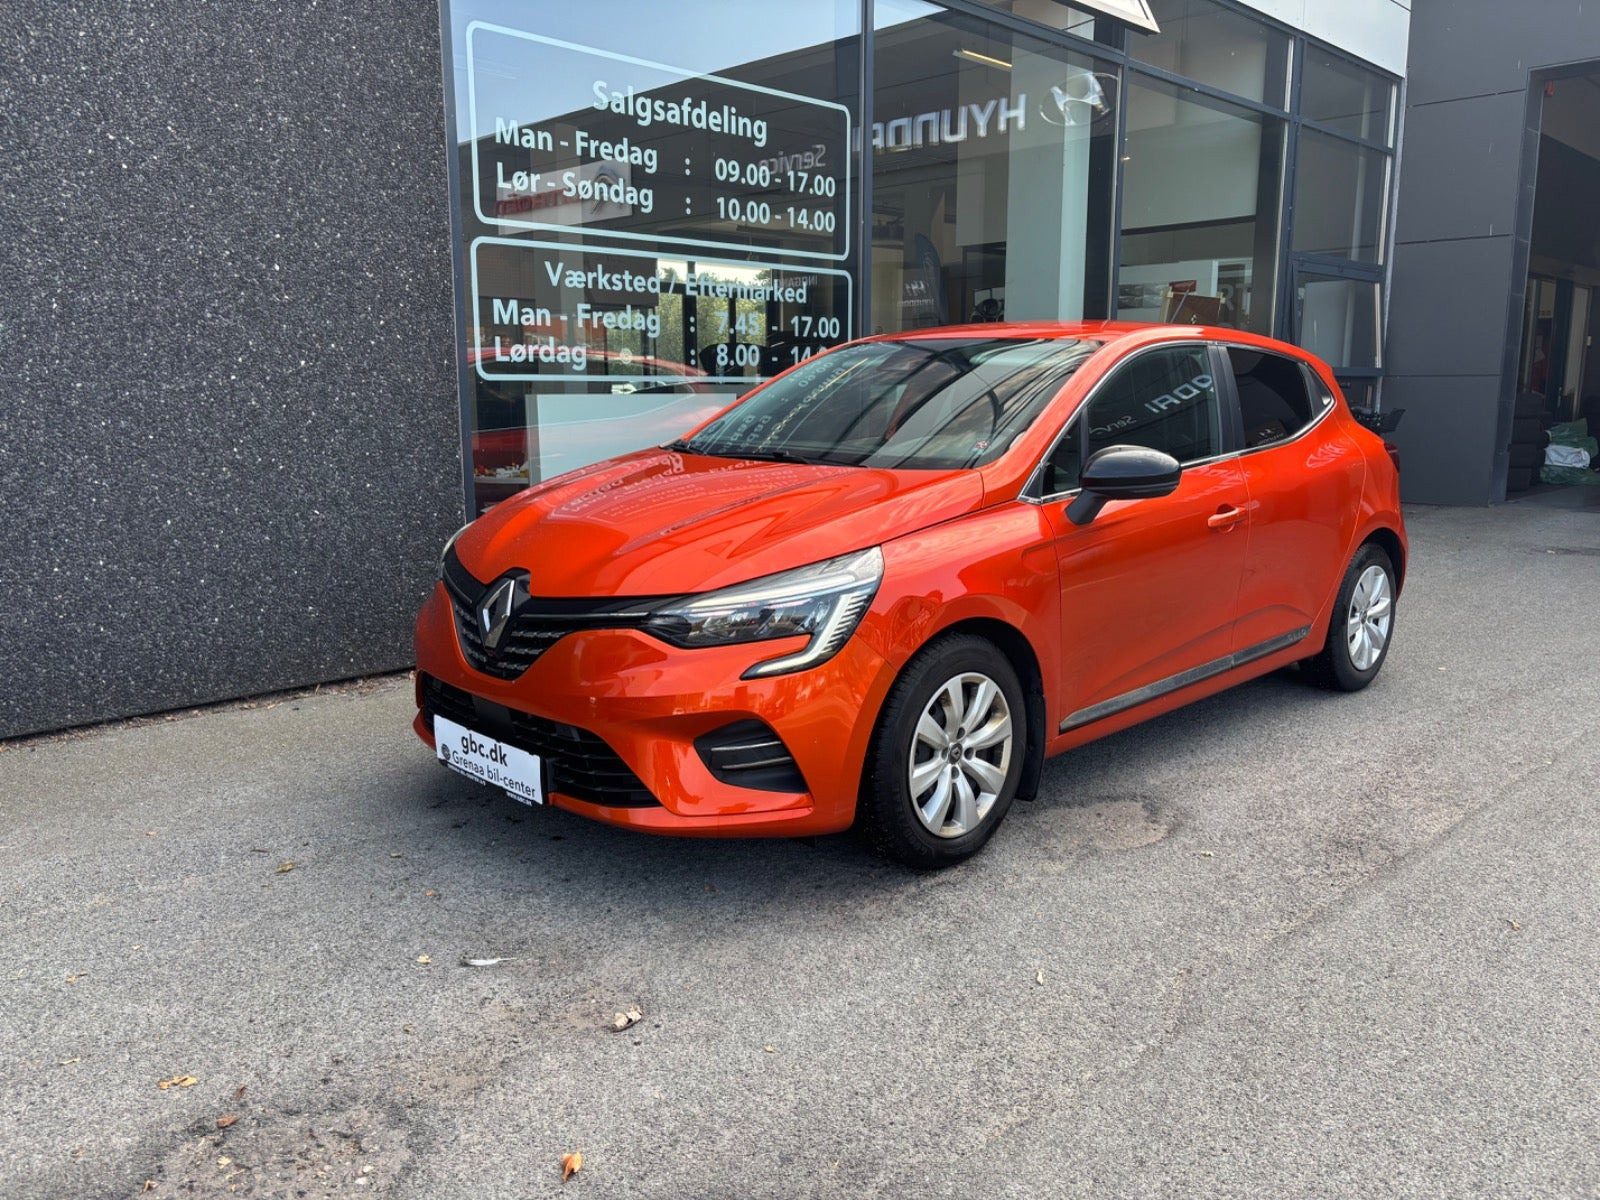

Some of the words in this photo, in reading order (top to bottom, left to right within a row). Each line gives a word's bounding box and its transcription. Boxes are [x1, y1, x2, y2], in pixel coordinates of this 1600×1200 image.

[592, 80, 768, 147] Salgsafdeling
[495, 117, 553, 152] Man
[575, 131, 658, 174] Fredag
[714, 158, 770, 187] 09.00
[787, 172, 836, 198] 17.00
[496, 161, 540, 192] Lør
[562, 173, 653, 213] Søndag
[716, 197, 770, 224] 10.00
[787, 208, 836, 233] 14.00
[544, 261, 661, 294] Værksted
[686, 273, 807, 304] Eftermarked
[492, 299, 551, 328] Man
[577, 303, 661, 338] Fredag
[716, 312, 760, 335] 7.45
[790, 315, 840, 338] 17.00
[494, 338, 587, 370] Lørdag
[716, 343, 760, 366] 8.00
[461, 733, 507, 764] gbc.dk
[452, 751, 484, 776] Grenaa
[487, 766, 535, 797] bil-center
